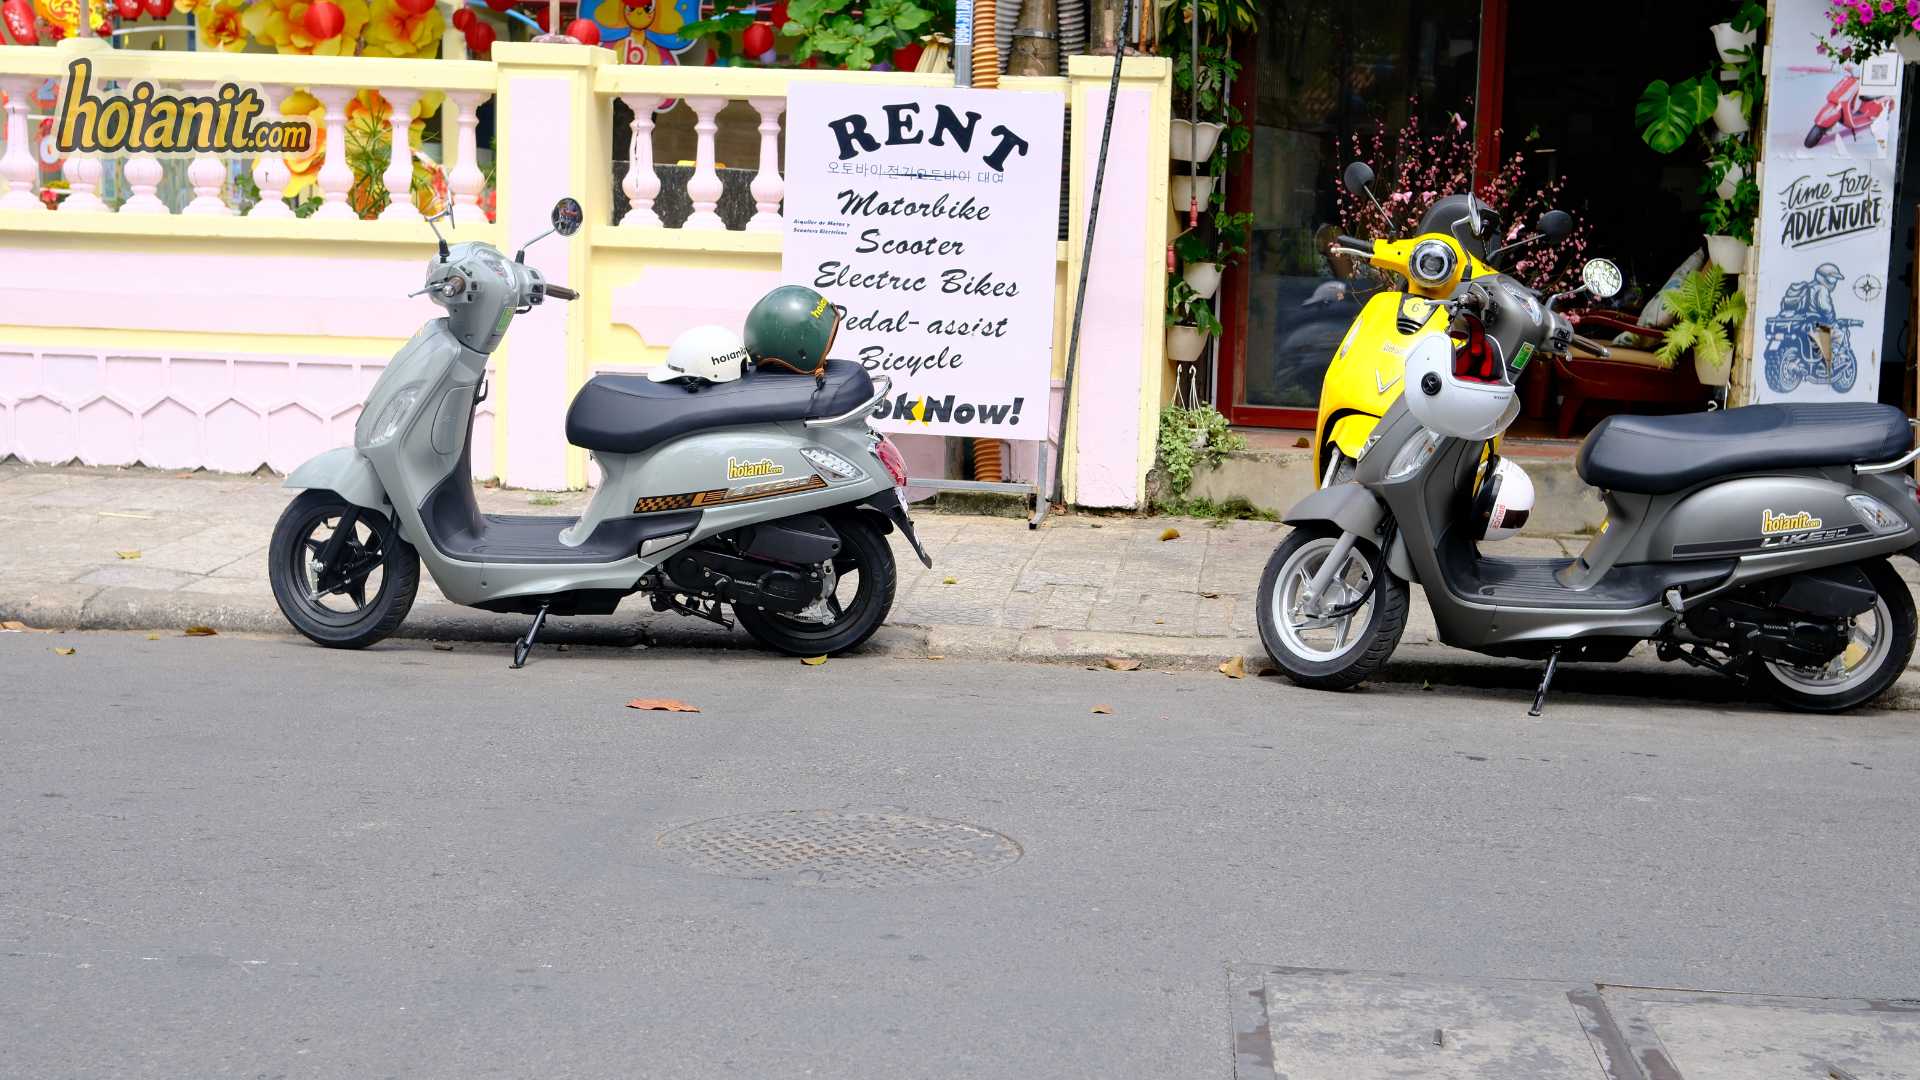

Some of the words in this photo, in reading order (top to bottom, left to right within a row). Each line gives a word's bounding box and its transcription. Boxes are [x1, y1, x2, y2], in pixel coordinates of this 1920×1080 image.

[828, 102, 1029, 173] RENT
[1778, 175, 1833, 209] Time
[1827, 167, 1872, 202] For
[837, 189, 990, 221] Motorbike
[1781, 197, 1882, 245] ADVENTURE
[856, 228, 966, 256] Scooter
[814, 261, 926, 291] Electric
[941, 268, 1020, 297] Bikes
[927, 316, 1009, 338] assist
[857, 345, 963, 377] Bicycle
[922, 395, 1025, 425] Now!
